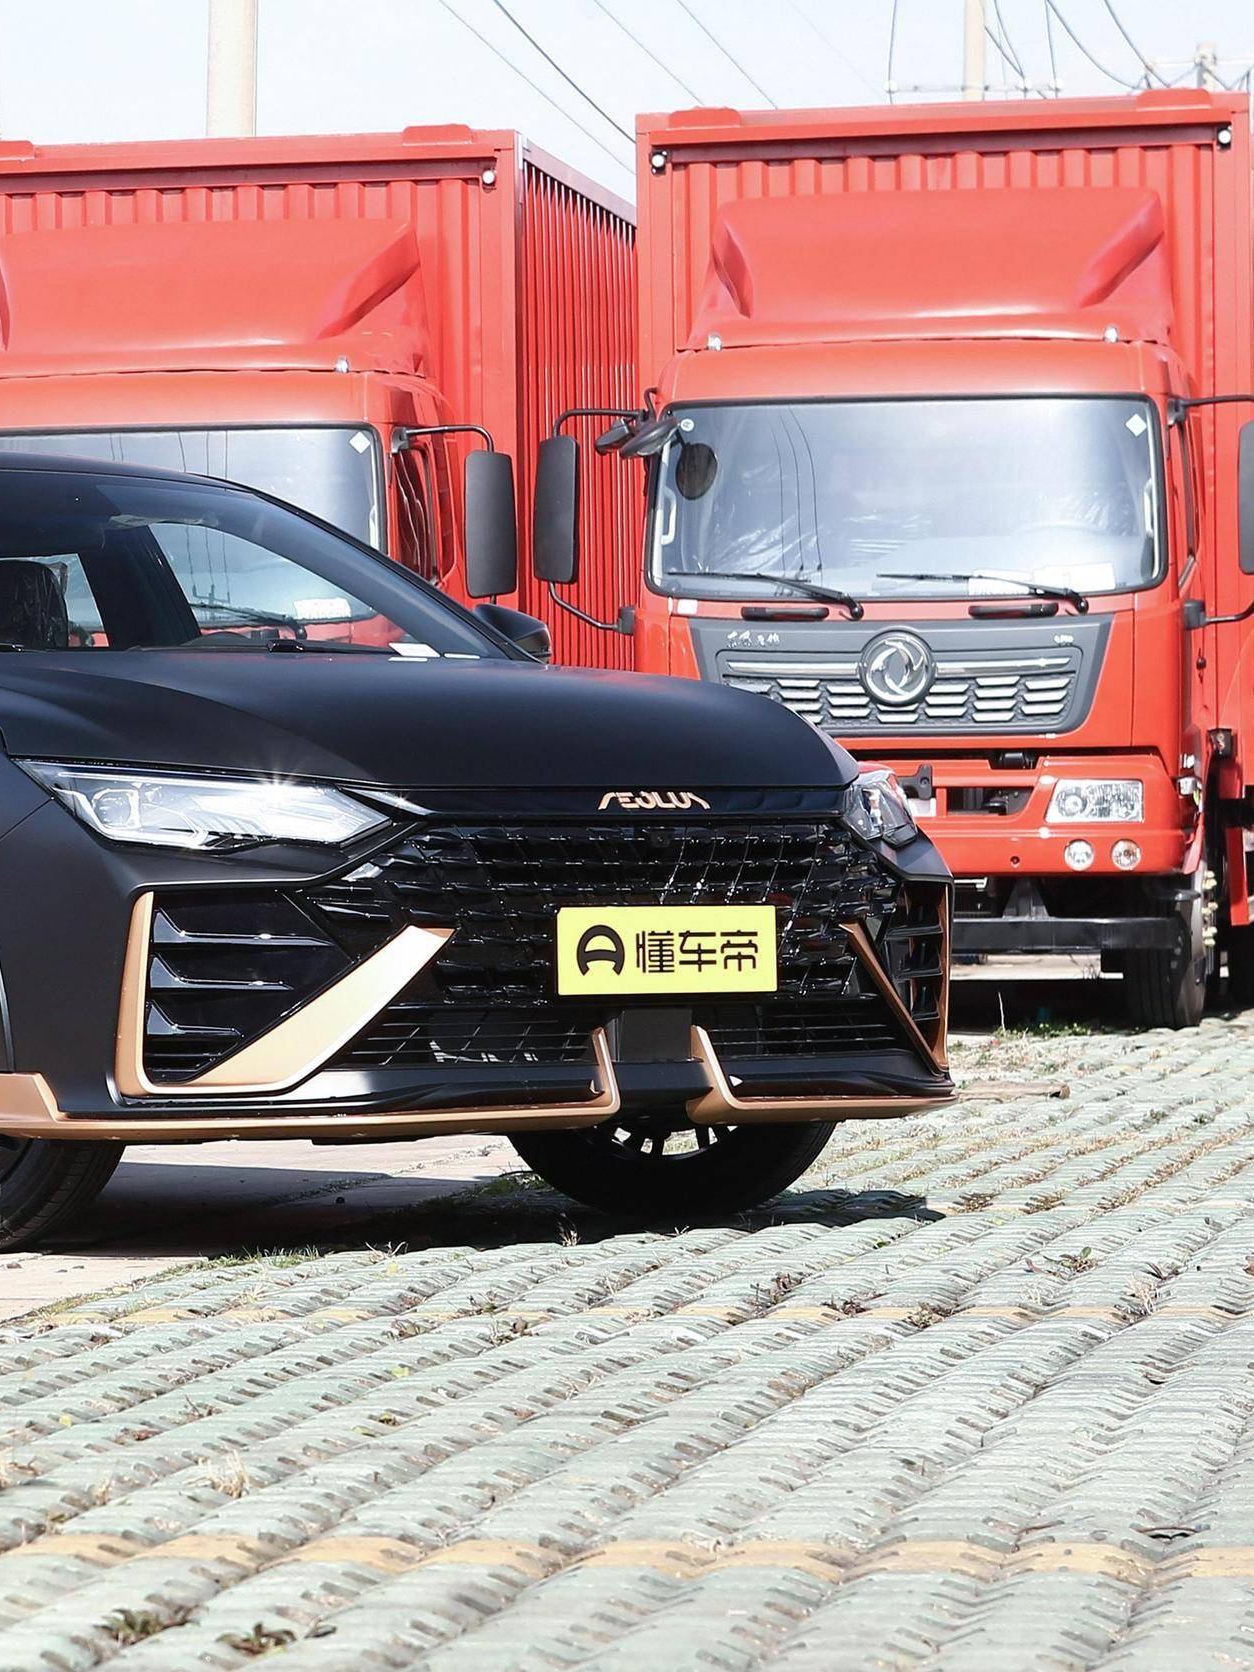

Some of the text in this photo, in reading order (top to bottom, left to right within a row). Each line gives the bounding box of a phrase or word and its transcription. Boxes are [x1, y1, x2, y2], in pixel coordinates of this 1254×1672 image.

[598, 790, 711, 810] AEOLUS
[636, 930, 759, 973] 懂车帝
